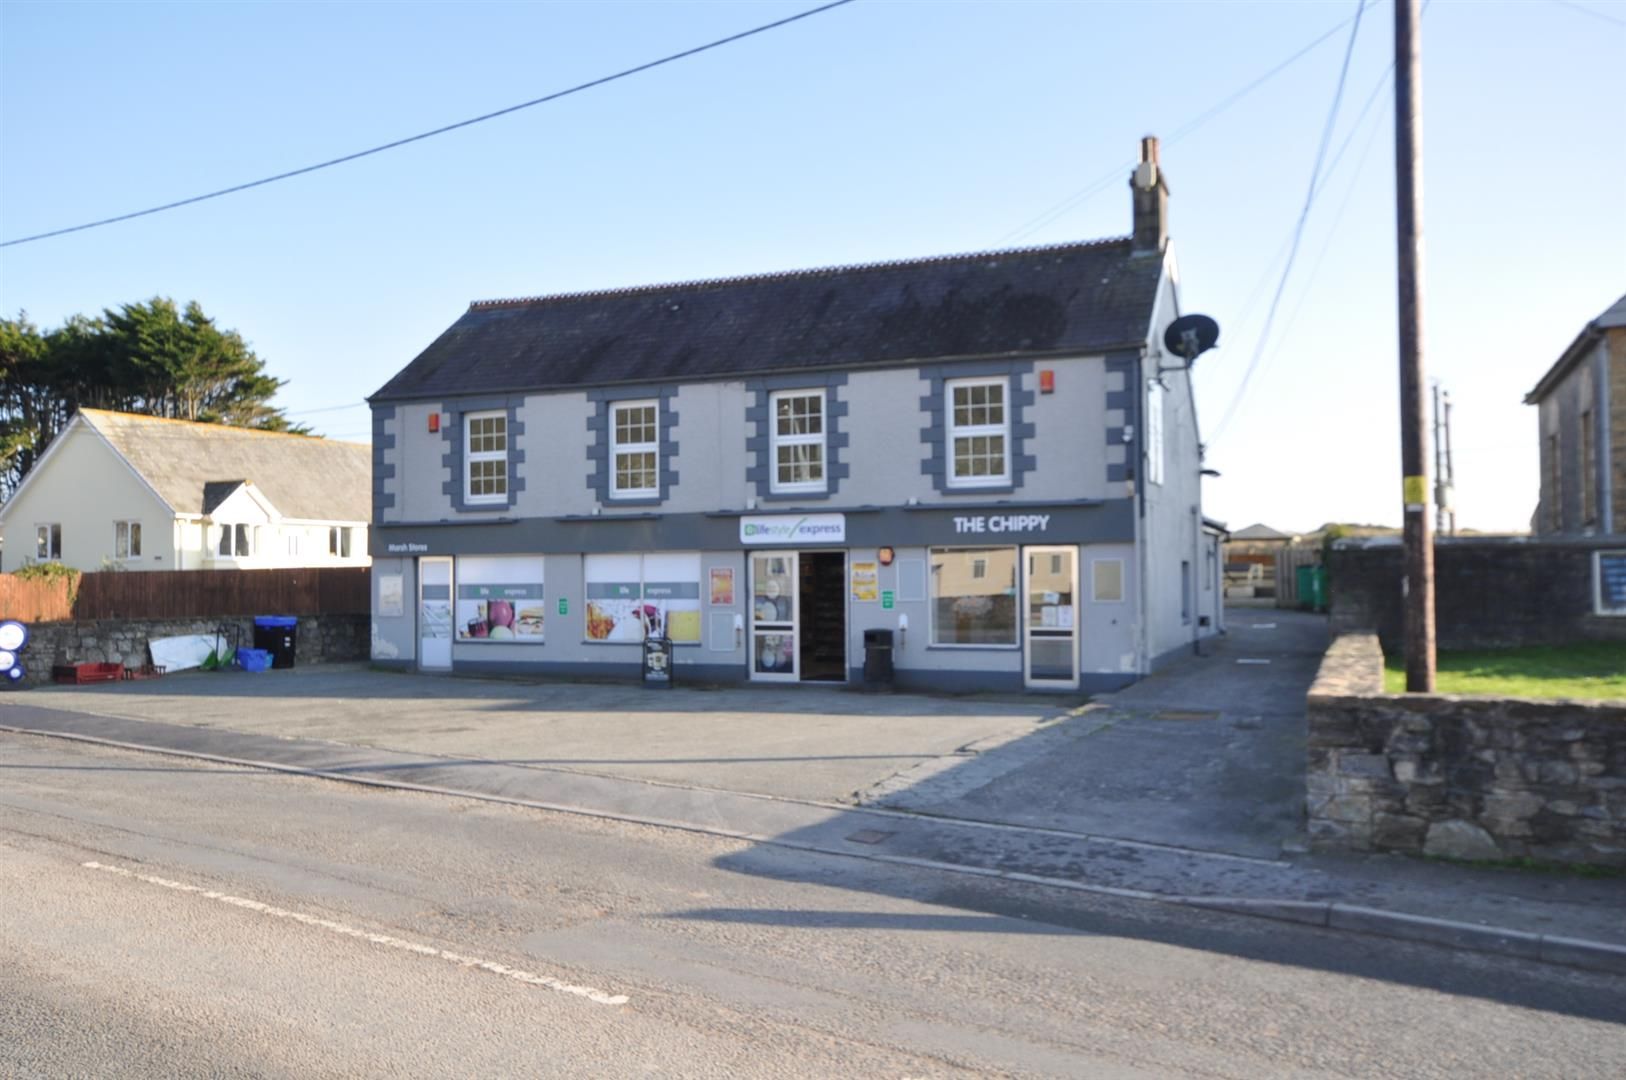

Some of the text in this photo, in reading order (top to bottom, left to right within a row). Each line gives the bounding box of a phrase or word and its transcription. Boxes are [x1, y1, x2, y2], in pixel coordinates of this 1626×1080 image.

[799, 524, 841, 535] express
[953, 514, 1050, 533] THE CHIPPY
